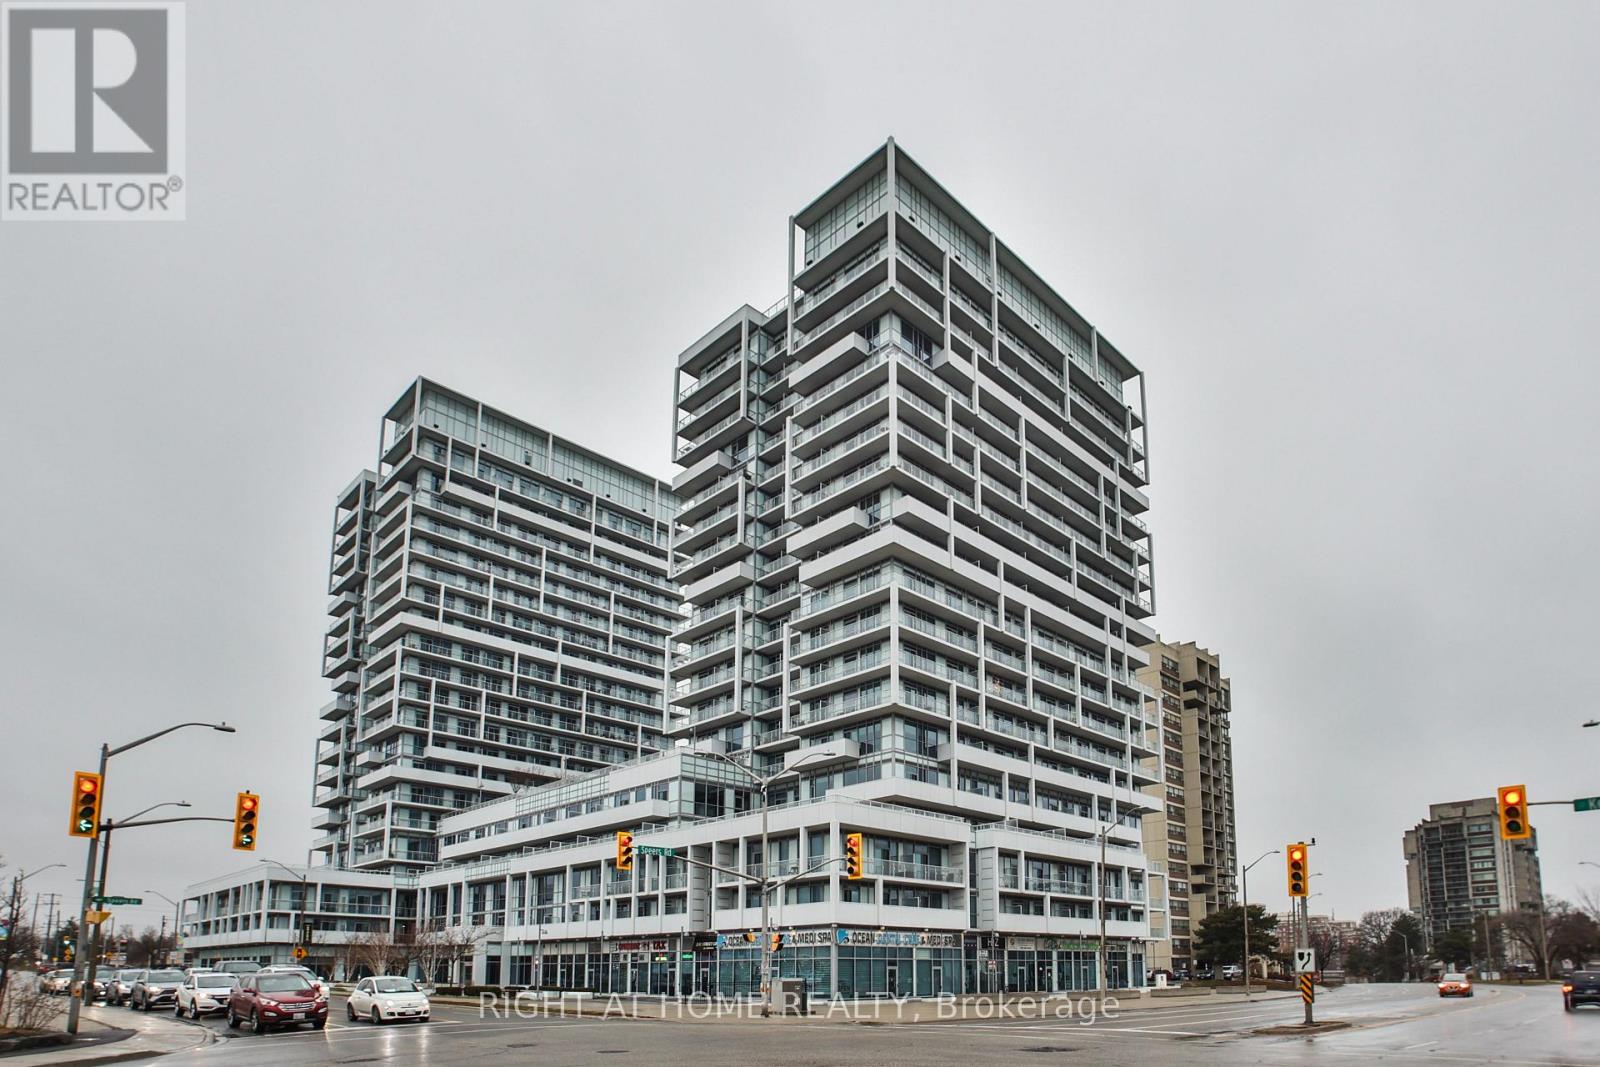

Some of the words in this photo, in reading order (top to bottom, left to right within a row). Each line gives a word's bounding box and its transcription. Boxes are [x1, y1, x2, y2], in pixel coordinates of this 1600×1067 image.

[640, 846, 662, 855] Speers
[664, 848, 672, 856] Rd
[852, 931, 875, 945] OCEAN
[652, 940, 667, 950] TAX
